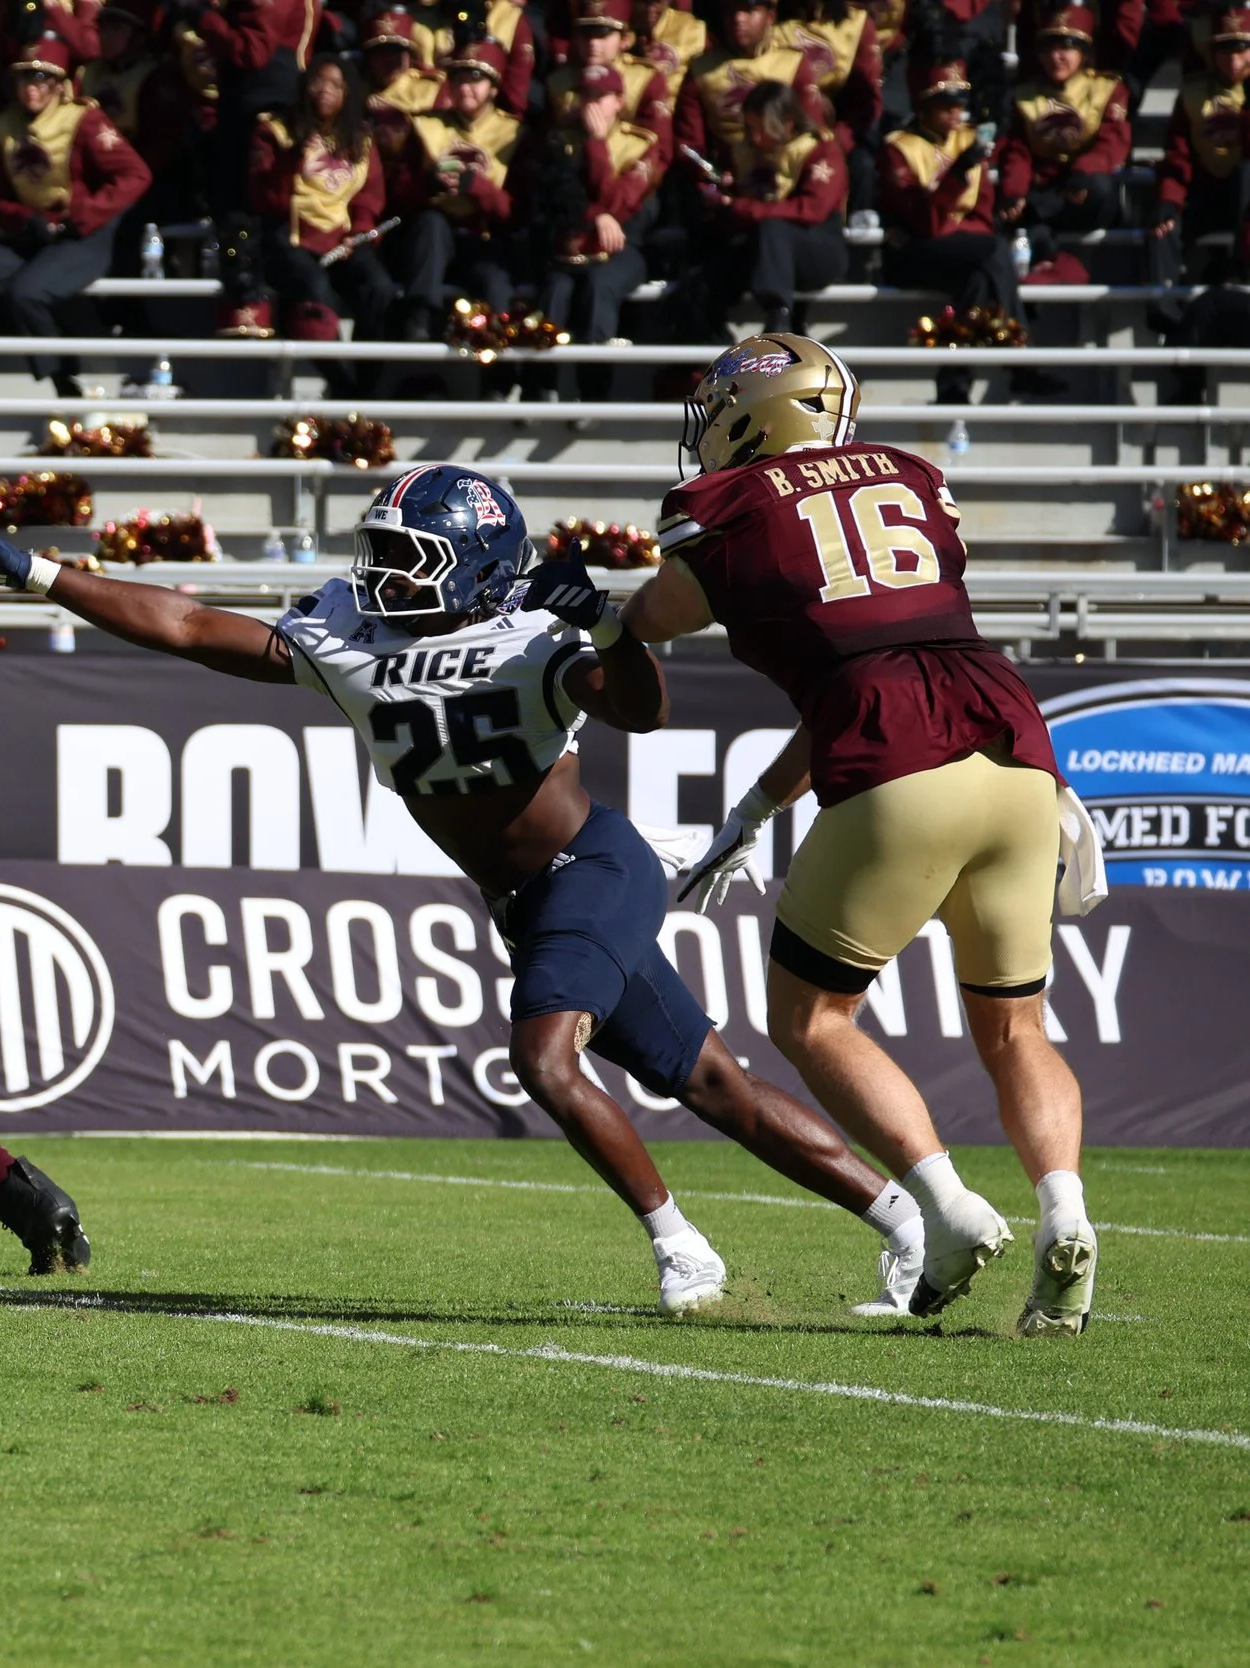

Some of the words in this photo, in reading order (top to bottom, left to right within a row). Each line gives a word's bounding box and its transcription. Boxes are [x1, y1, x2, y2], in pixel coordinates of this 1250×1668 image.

[797, 453, 900, 489] SMITH
[375, 509, 388, 520] WE
[796, 482, 941, 604] 16
[371, 646, 496, 690] RICE
[368, 688, 546, 796] 25
[1067, 749, 1206, 774] LOCKHEED
[57, 723, 470, 878] BOW
[1091, 805, 1190, 848] MED
[1142, 867, 1250, 891] BOW
